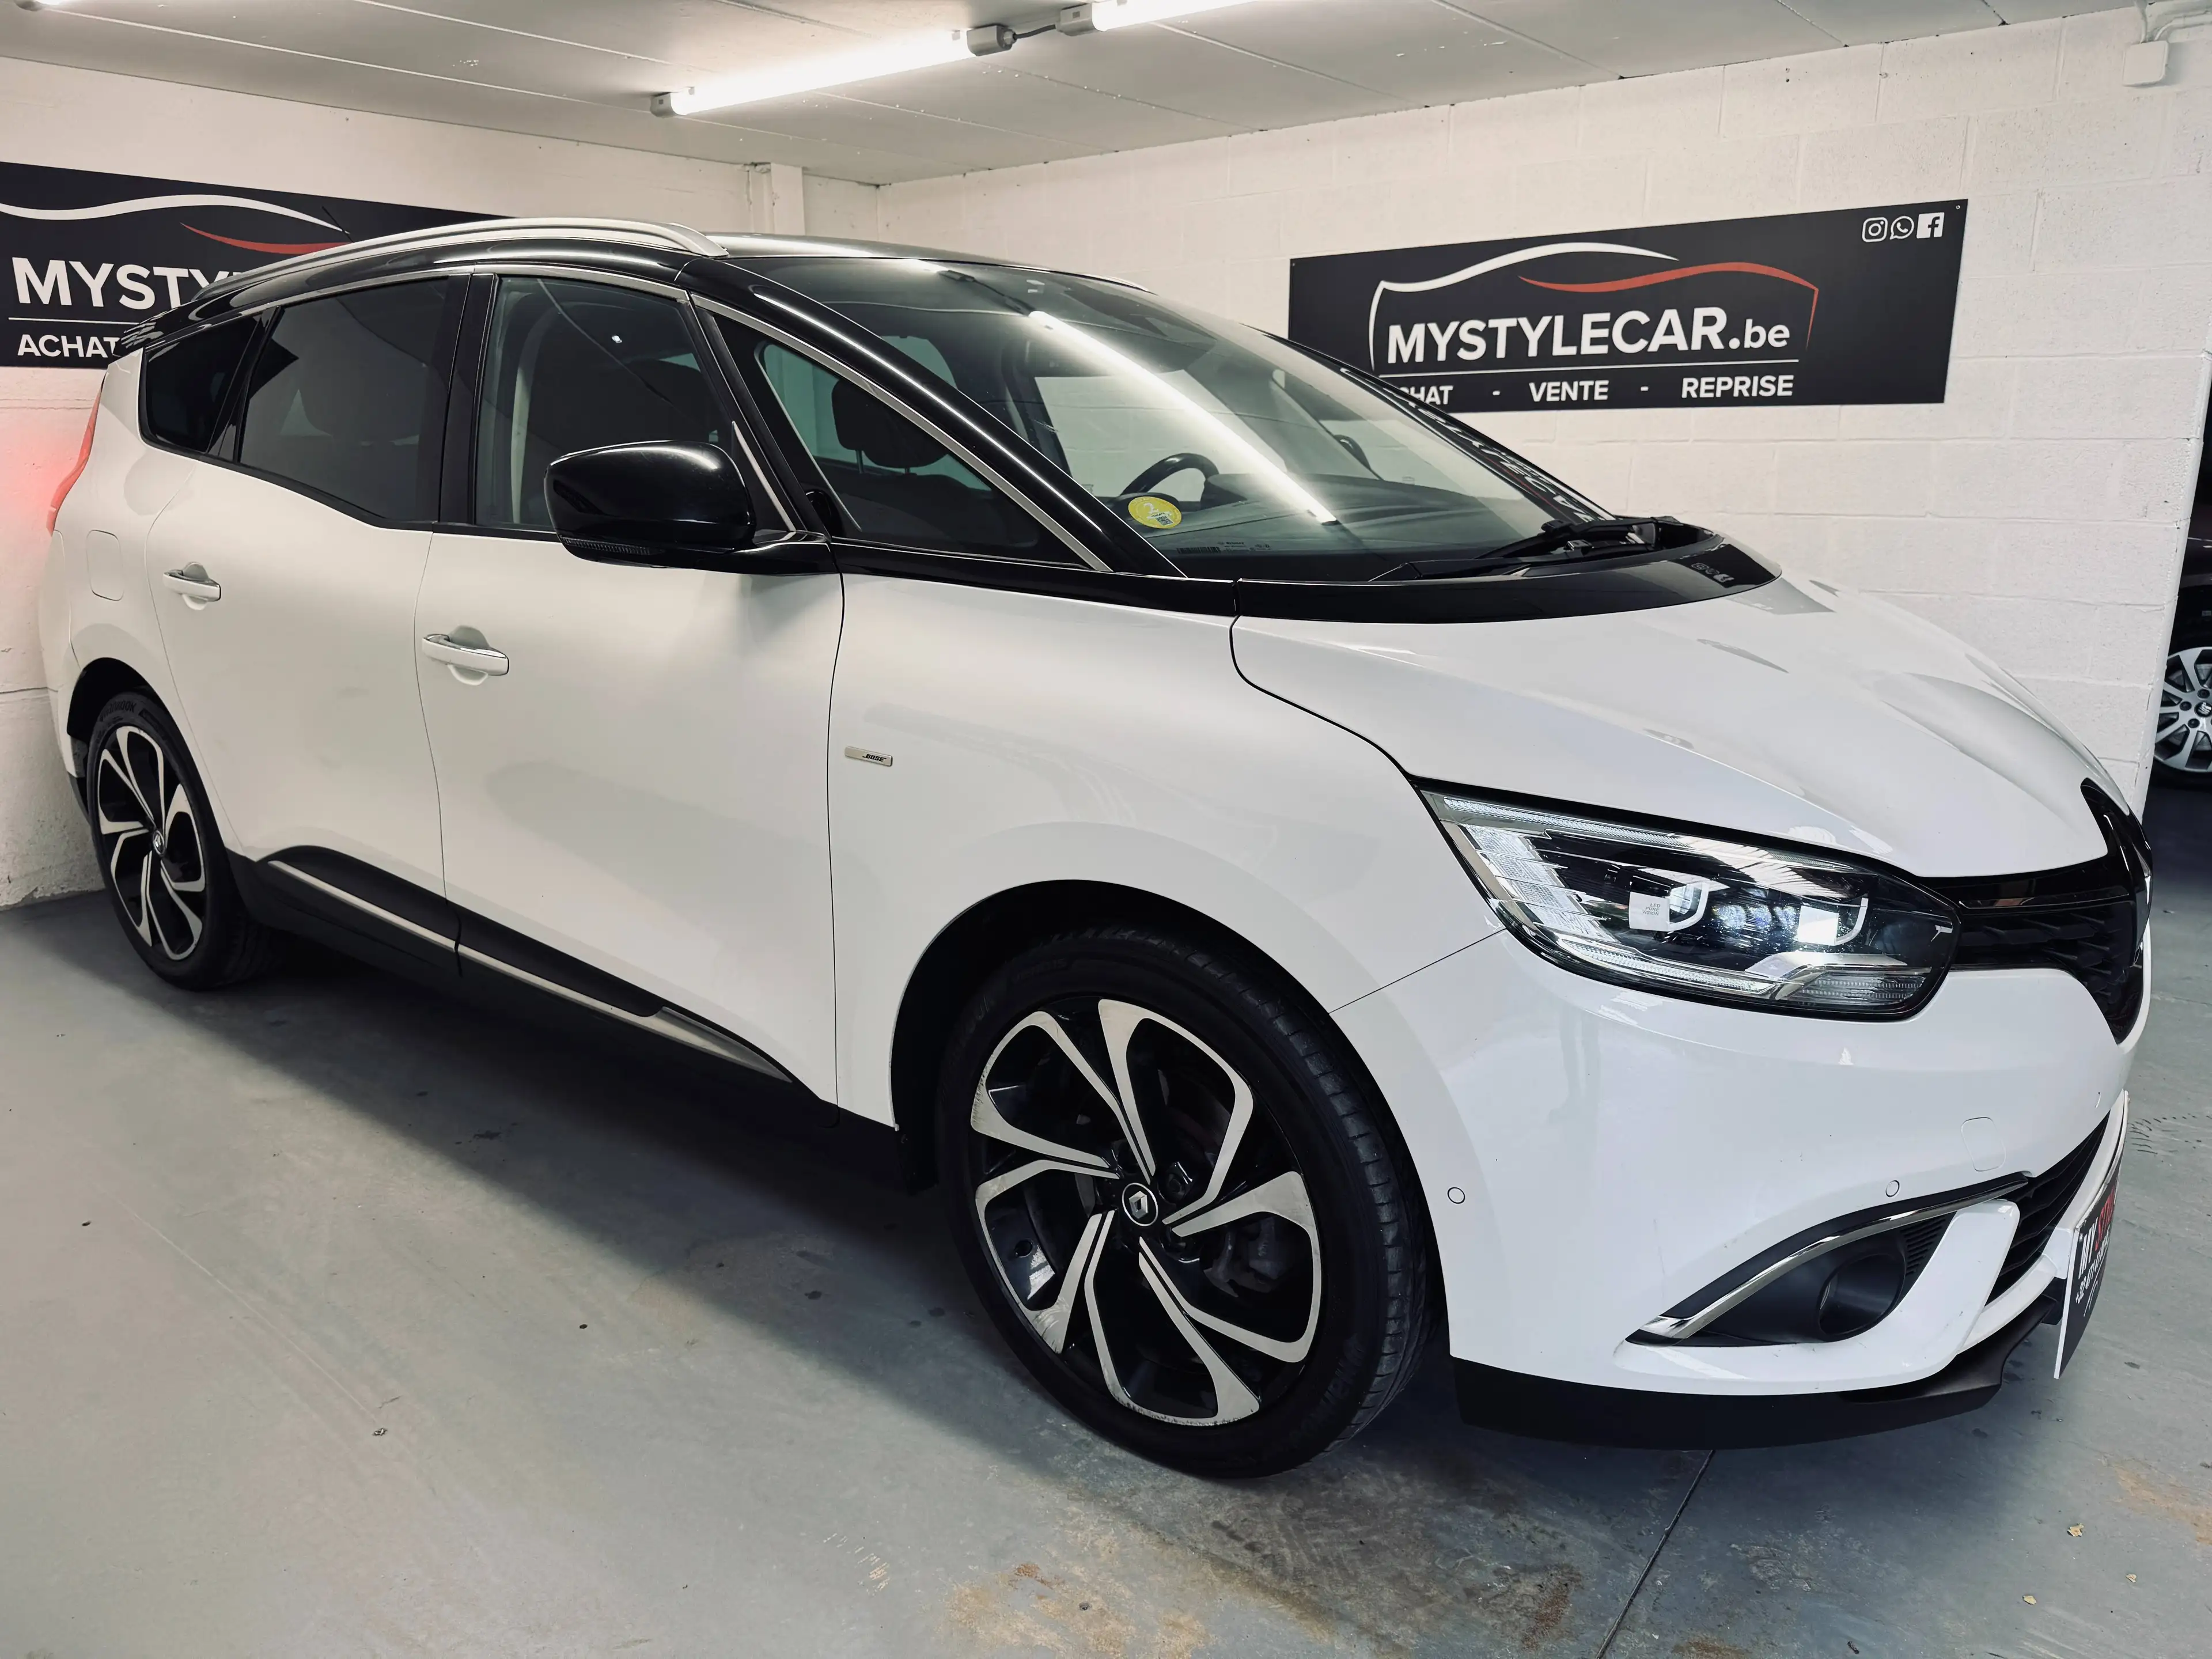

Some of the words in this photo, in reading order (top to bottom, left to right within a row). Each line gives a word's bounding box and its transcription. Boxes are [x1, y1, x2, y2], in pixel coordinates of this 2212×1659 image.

[12, 257, 242, 310] MYSTY
[17, 334, 120, 358] ACHAT
[1388, 306, 1790, 363] MYSTYLECAR.be
[1399, 385, 1454, 405] HAT
[1529, 380, 1609, 402] VENTE
[1681, 375, 1794, 398] REPRISE
[862, 753, 887, 762] BOSE
